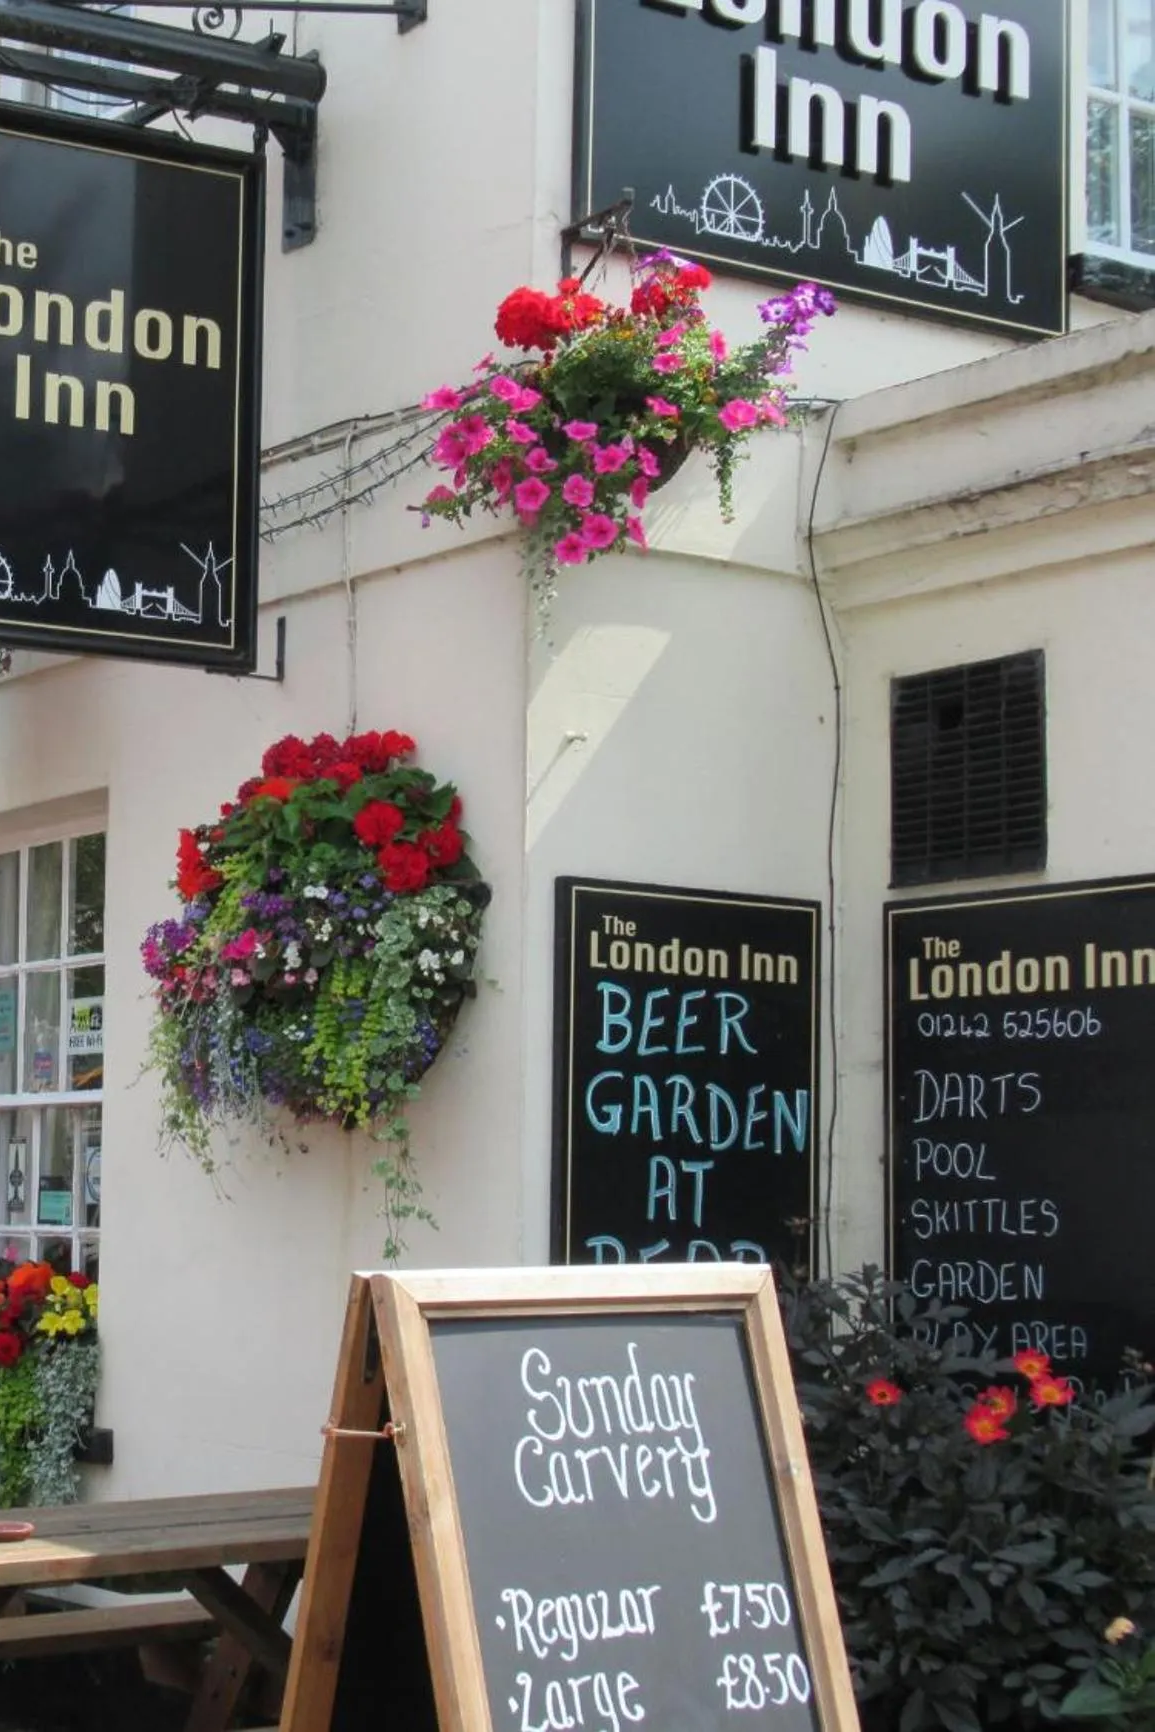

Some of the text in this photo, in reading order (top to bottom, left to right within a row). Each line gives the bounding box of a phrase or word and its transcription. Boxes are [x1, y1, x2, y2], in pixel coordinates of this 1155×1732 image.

[649, 0, 1030, 99] ndon
[752, 46, 912, 182] Inn
[15, 354, 136, 435] Inn
[602, 914, 637, 937] The
[922, 936, 961, 959] The
[590, 931, 799, 984] London Inn
[909, 942, 1155, 1000] London Inn
[596, 981, 758, 1056] BEER
[918, 1006, 1102, 1038] 01242 525606
[585, 1071, 808, 1155] GARDEN
[913, 1069, 1042, 1124] DARTS
[913, 1137, 997, 1182] POOL
[647, 1155, 715, 1228] AT
[910, 1198, 1060, 1239] SKITTLES
[910, 1259, 1043, 1304] GARDEN
[1011, 1320, 1088, 1360] AREA
[521, 1342, 709, 1456] Sunday
[514, 1436, 717, 1524] Carvery
[700, 1581, 791, 1638] £7.50
[716, 1653, 810, 1711] £8.50
